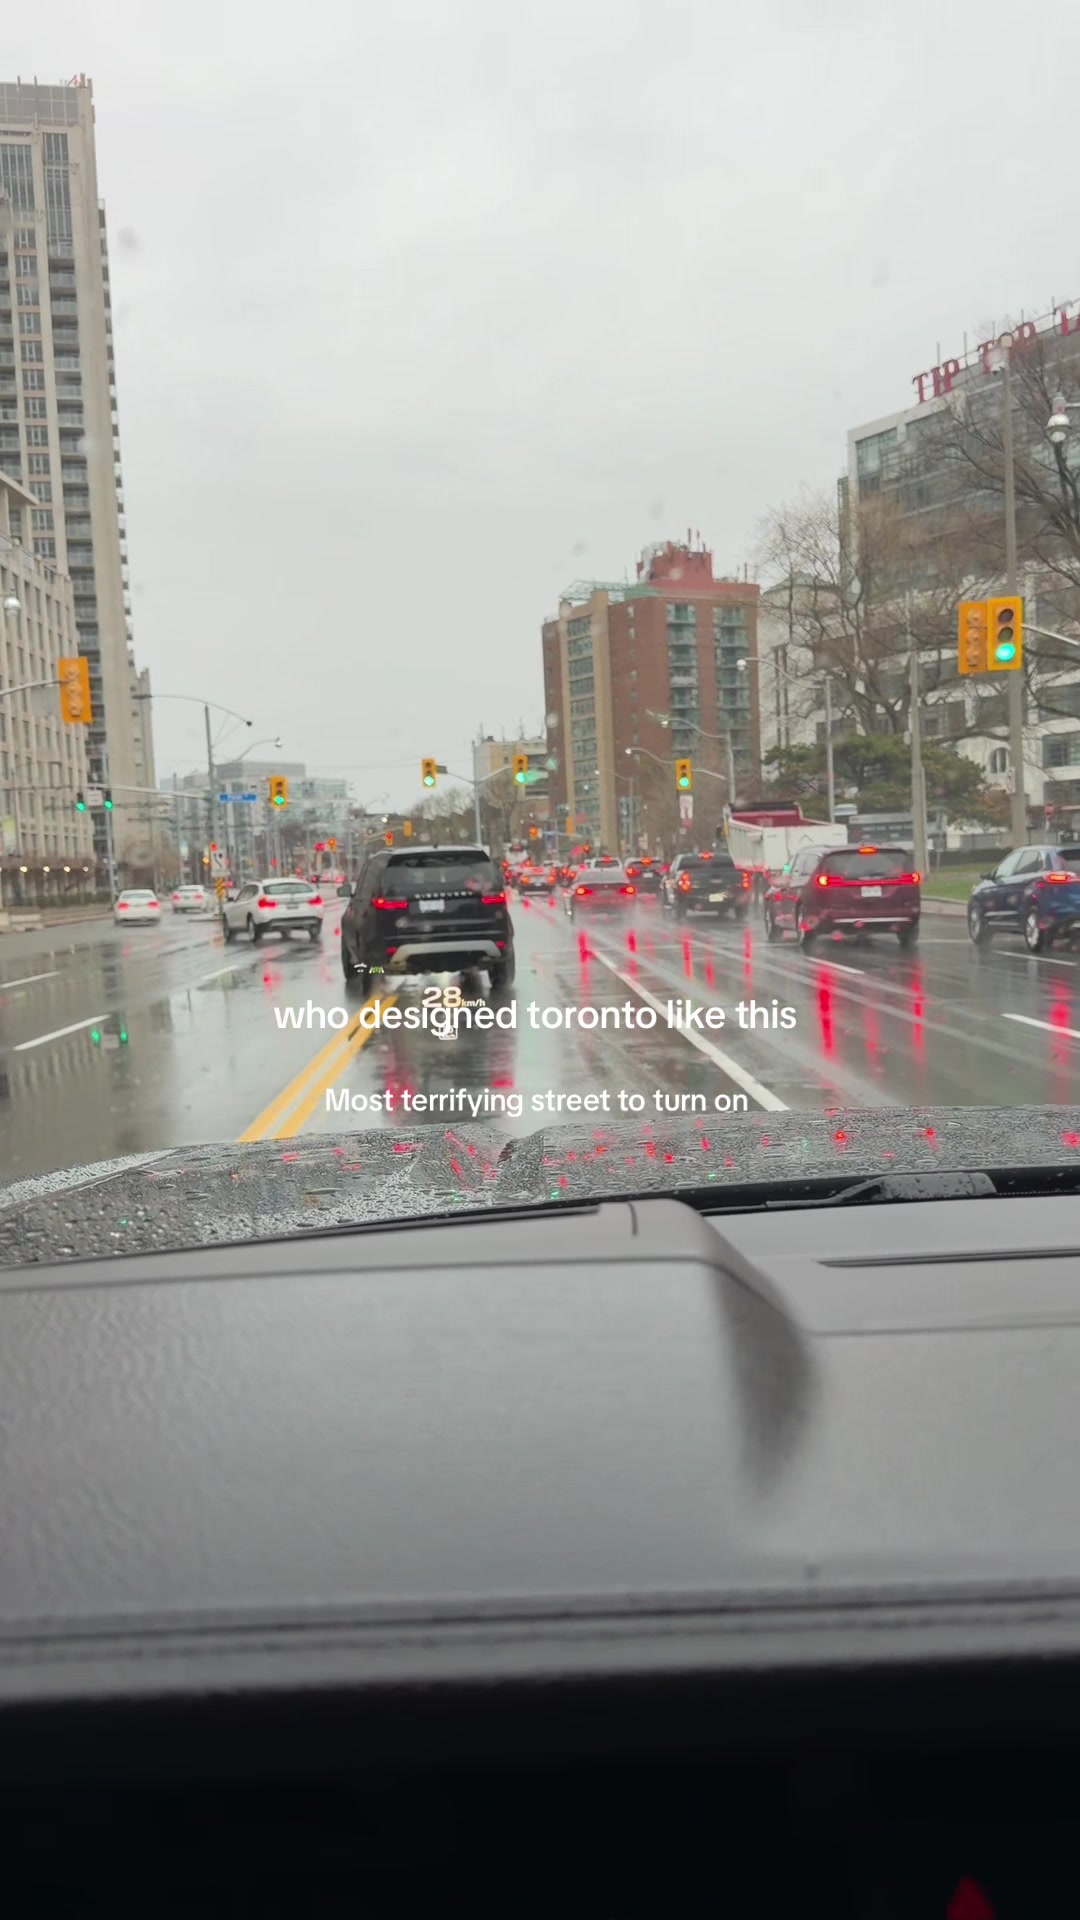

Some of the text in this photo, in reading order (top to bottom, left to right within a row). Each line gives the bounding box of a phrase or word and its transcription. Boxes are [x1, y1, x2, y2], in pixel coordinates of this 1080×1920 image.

[912, 358, 960, 404] TIP
[1054, 300, 1080, 337] T
[422, 986, 461, 1008] 28
